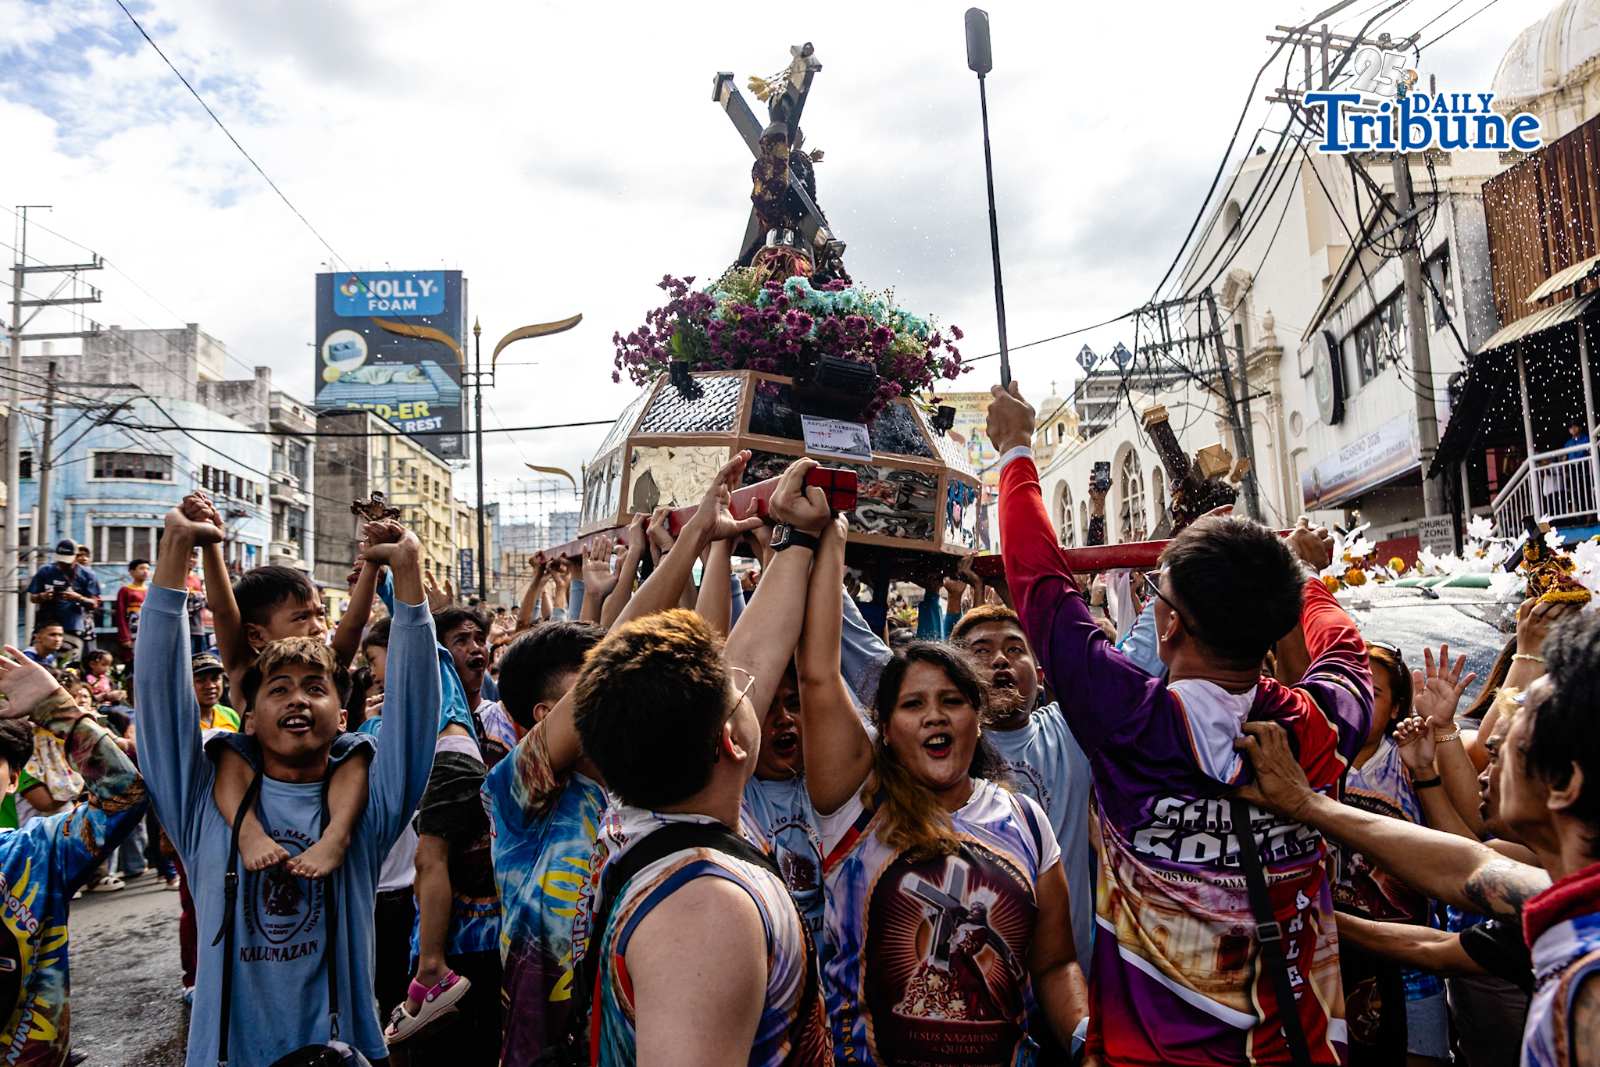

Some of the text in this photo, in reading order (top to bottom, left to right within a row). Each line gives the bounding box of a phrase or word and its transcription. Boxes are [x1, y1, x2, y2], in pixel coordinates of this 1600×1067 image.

[366, 279, 434, 298] JOLLY
[368, 299, 417, 311] FOAM
[406, 417, 442, 432] REST
[1419, 519, 1452, 529] CHURCH
[1424, 528, 1449, 538] ZONE
[240, 940, 319, 962] KALUNAZAN
